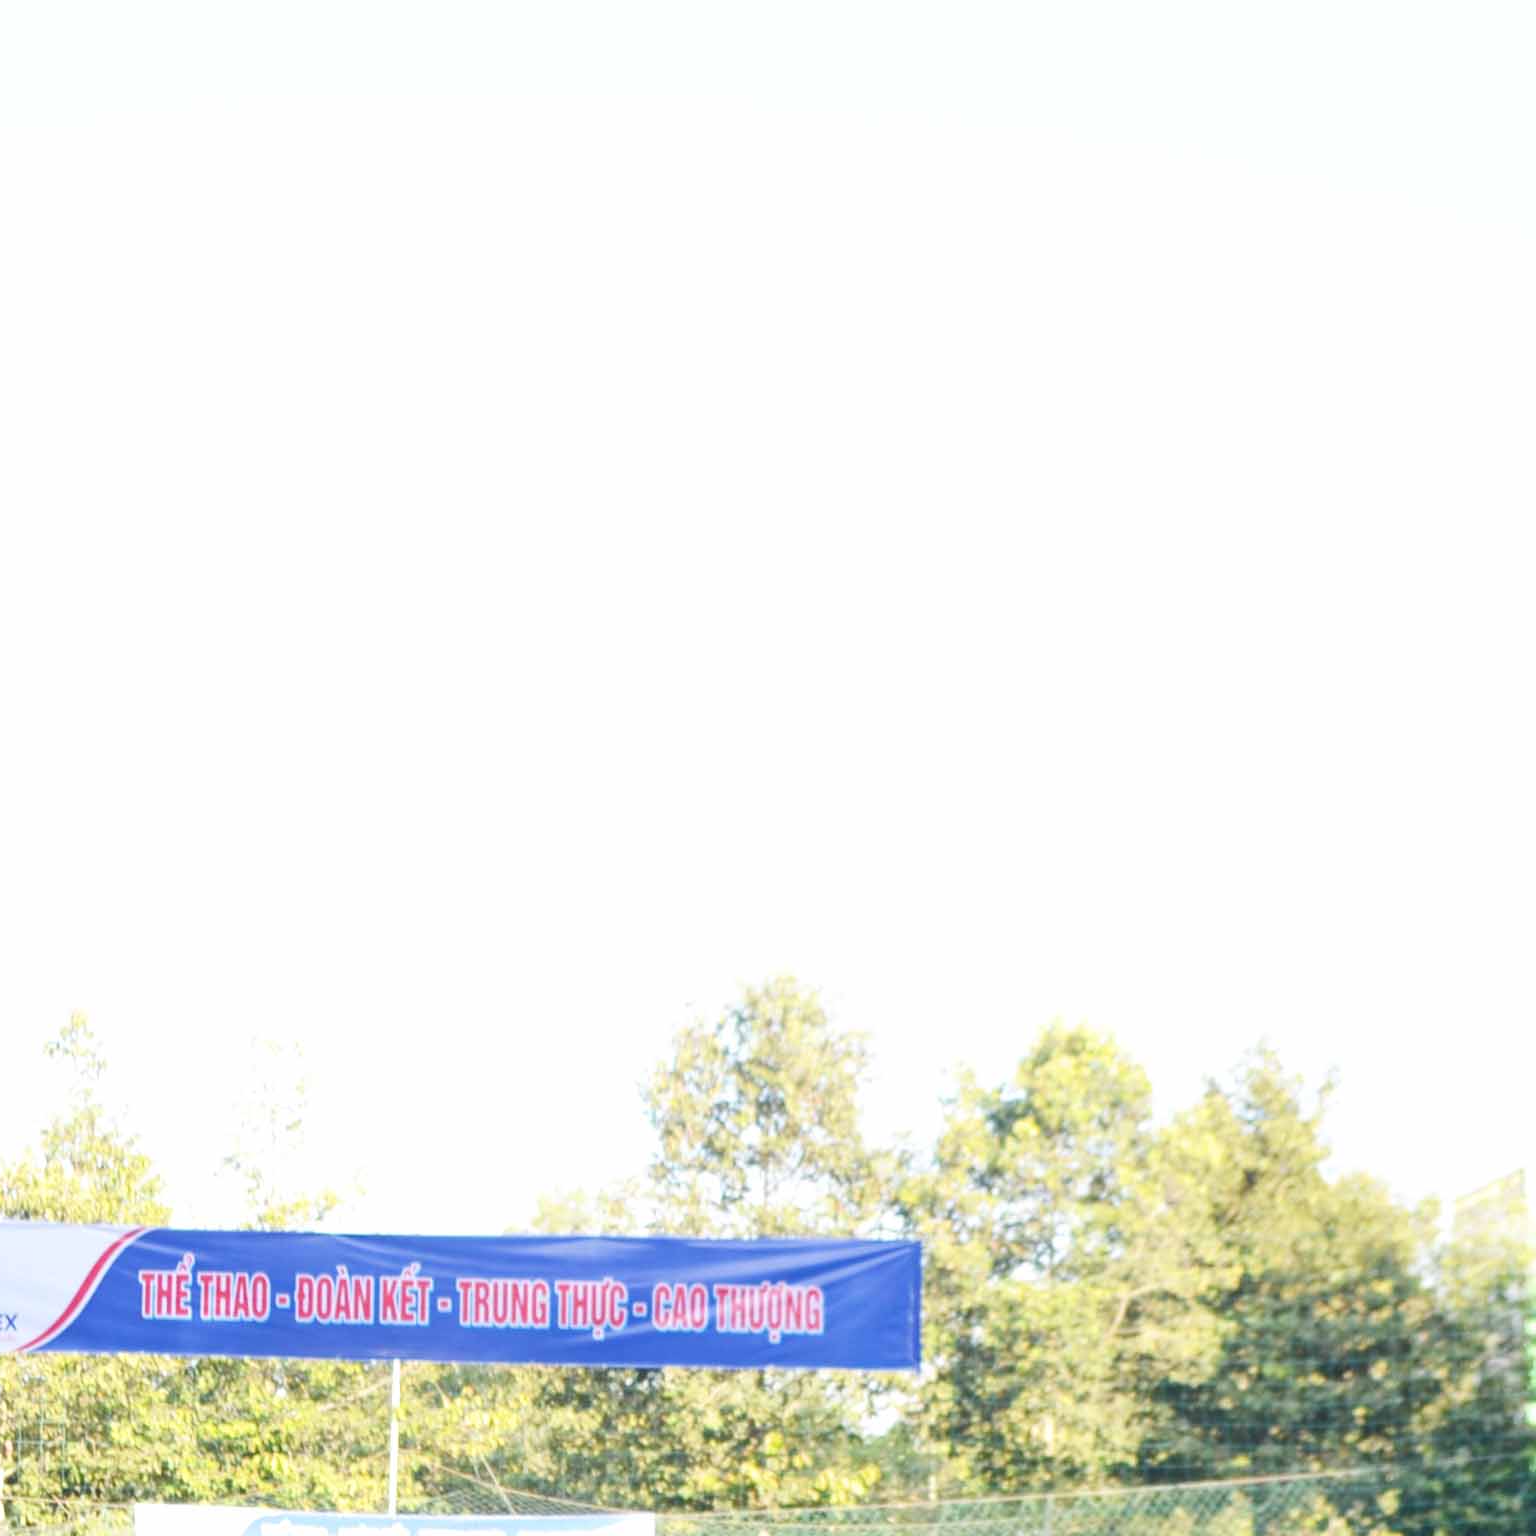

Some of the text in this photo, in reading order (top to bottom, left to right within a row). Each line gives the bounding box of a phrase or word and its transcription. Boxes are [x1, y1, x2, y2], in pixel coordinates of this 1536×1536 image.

[140, 1253, 194, 1318] THỂ
[199, 1272, 269, 1320] THAO
[295, 1265, 373, 1323] ĐOÀN
[380, 1262, 432, 1323] KẾT
[457, 1278, 549, 1328] TRUNG
[555, 1278, 627, 1340] THỰC
[653, 1282, 707, 1332] CAO
[714, 1281, 824, 1343] THƯỢNG
